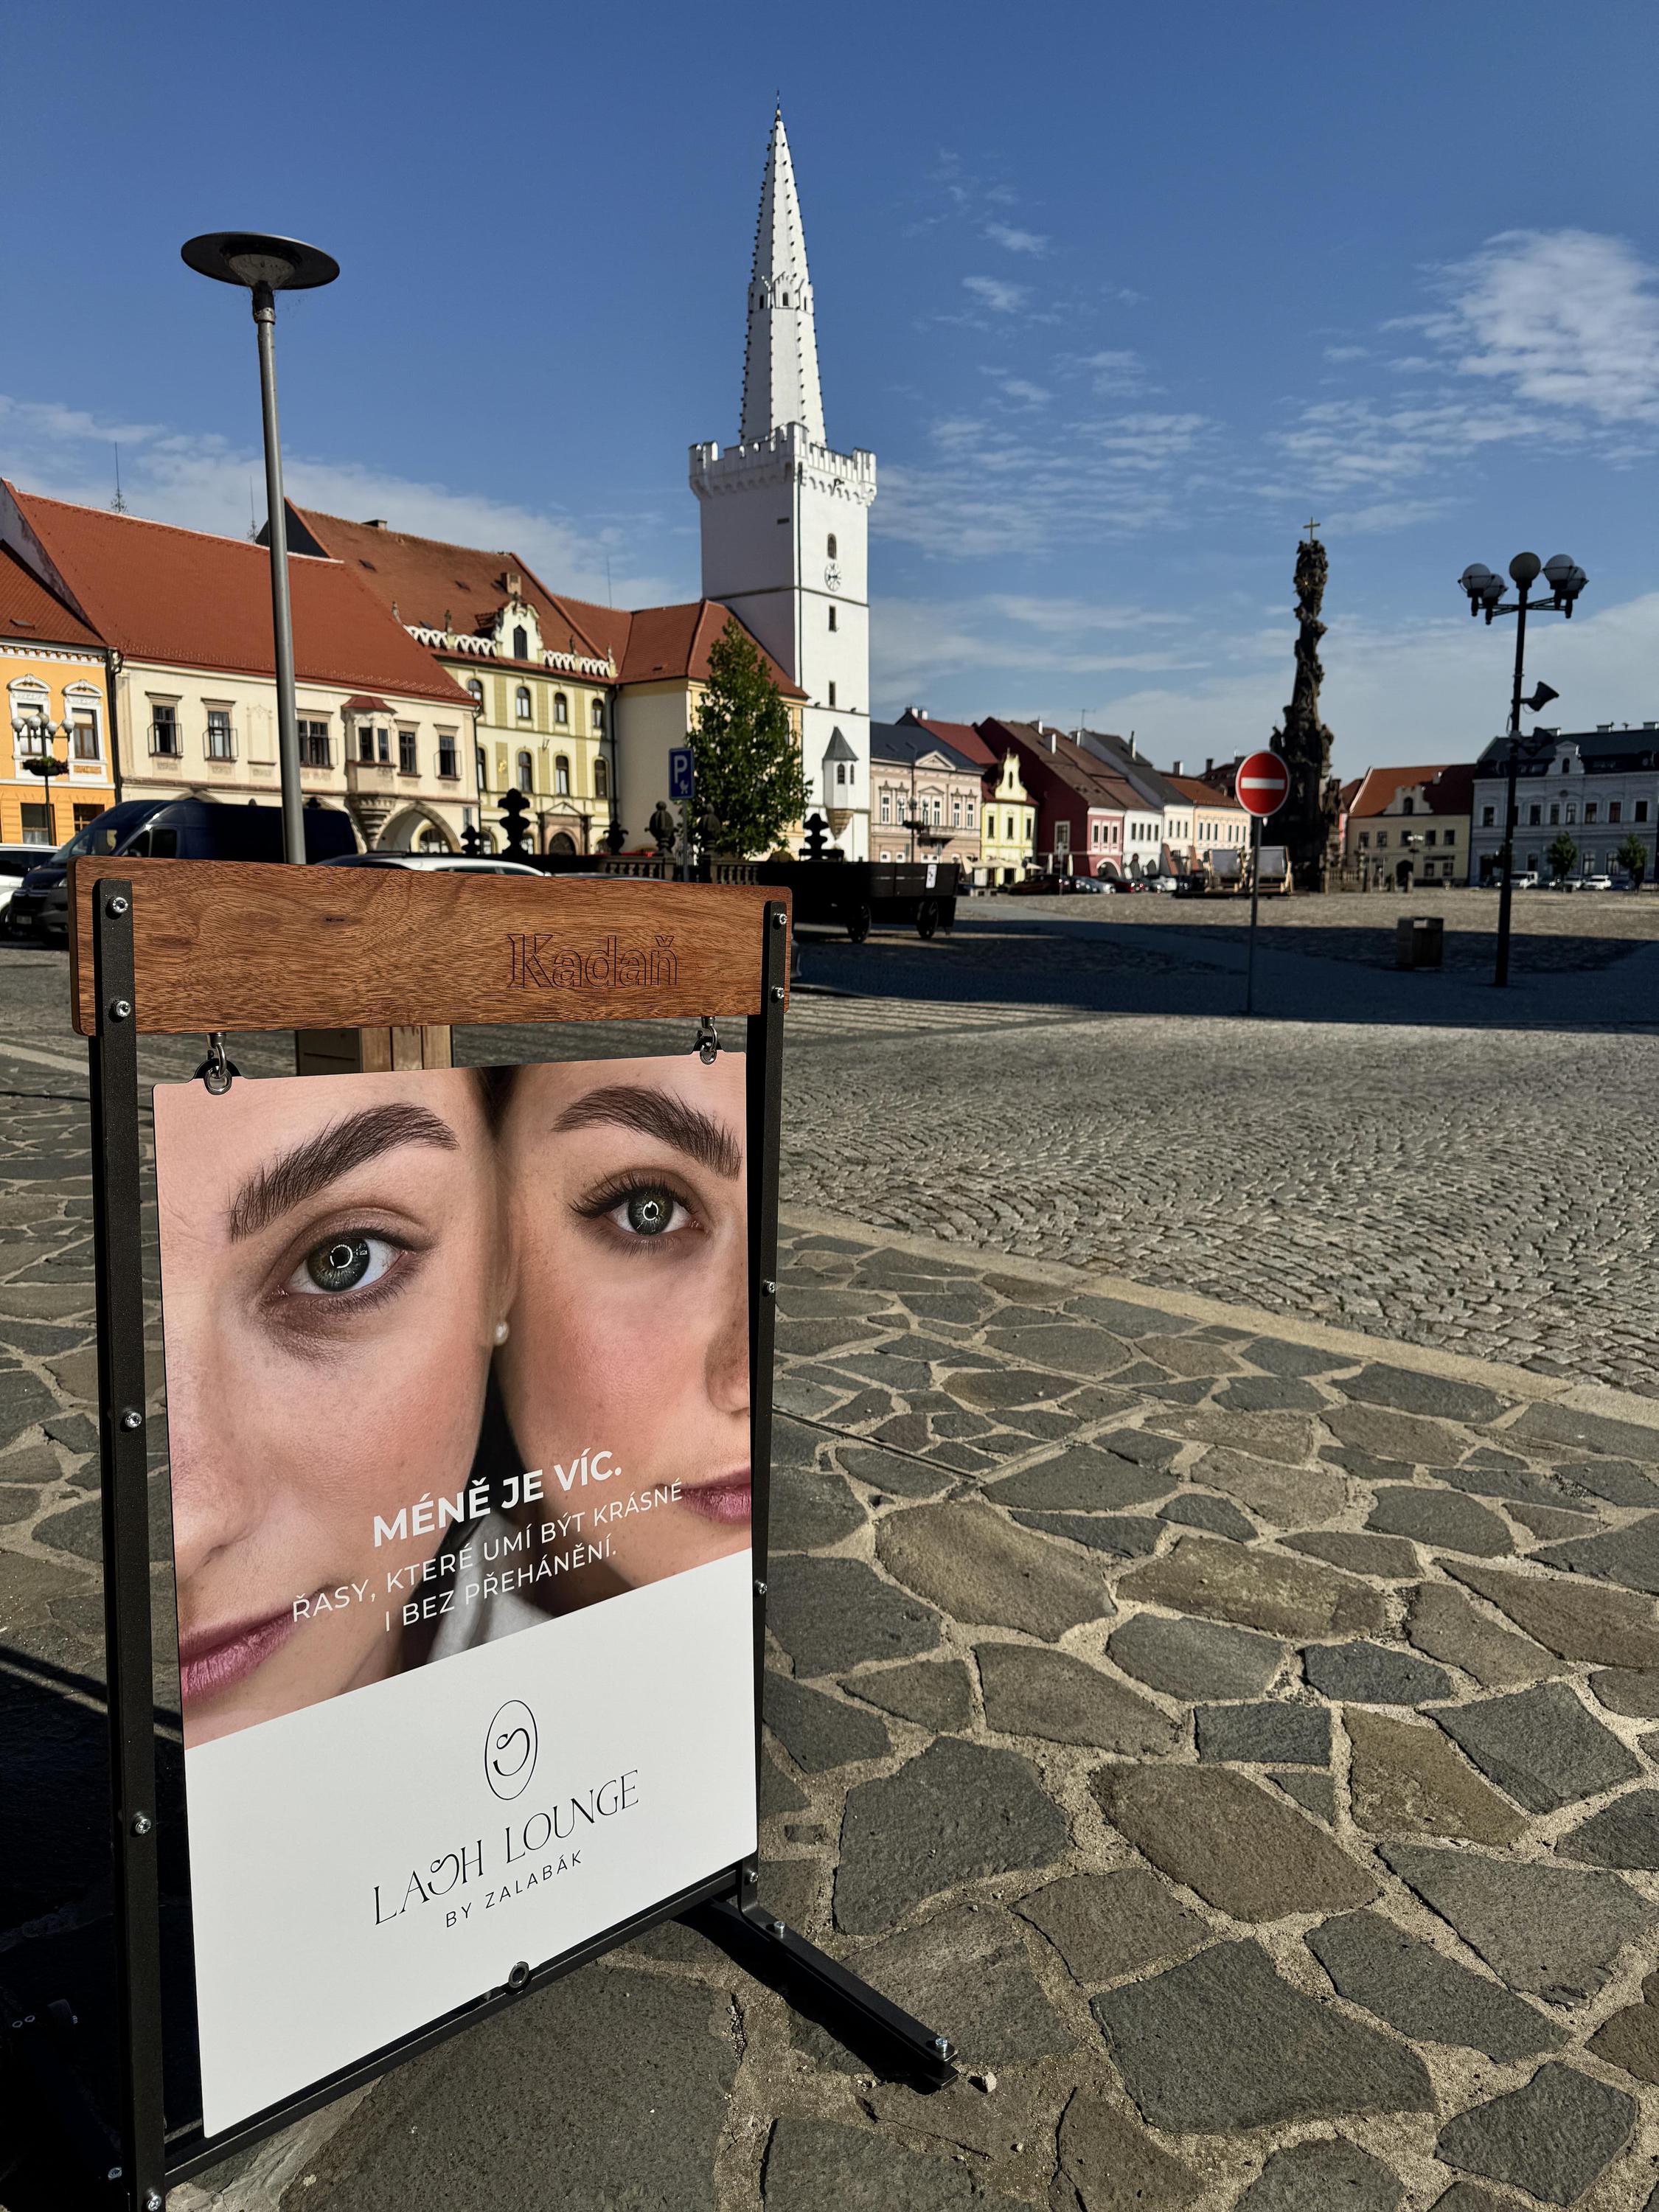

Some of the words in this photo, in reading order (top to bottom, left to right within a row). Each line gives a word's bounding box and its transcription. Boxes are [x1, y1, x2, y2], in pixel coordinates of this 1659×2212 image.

[674, 755, 688, 784] P
[507, 933, 678, 988] Kadaň
[373, 1478, 491, 1547] MÉNĚ
[501, 1469, 543, 1509] JE
[554, 1447, 623, 1492] VÍC.
[292, 1579, 377, 1623] ŘASY,
[386, 1543, 474, 1595] KTERÉ
[484, 1524, 532, 1562] UMÍ
[541, 1508, 586, 1545] BÝT
[594, 1478, 684, 1527] KRÁSNÉ
[385, 1611, 391, 1632] I
[403, 1590, 456, 1626] BEZ
[465, 1533, 617, 1606] PŘEHÁNĚNÍ.
[374, 1839, 484, 1925] LASH
[505, 1770, 639, 1864] LOUNGE
[445, 1902, 472, 1928] BY
[485, 1849, 582, 1908] ZALABÁK
